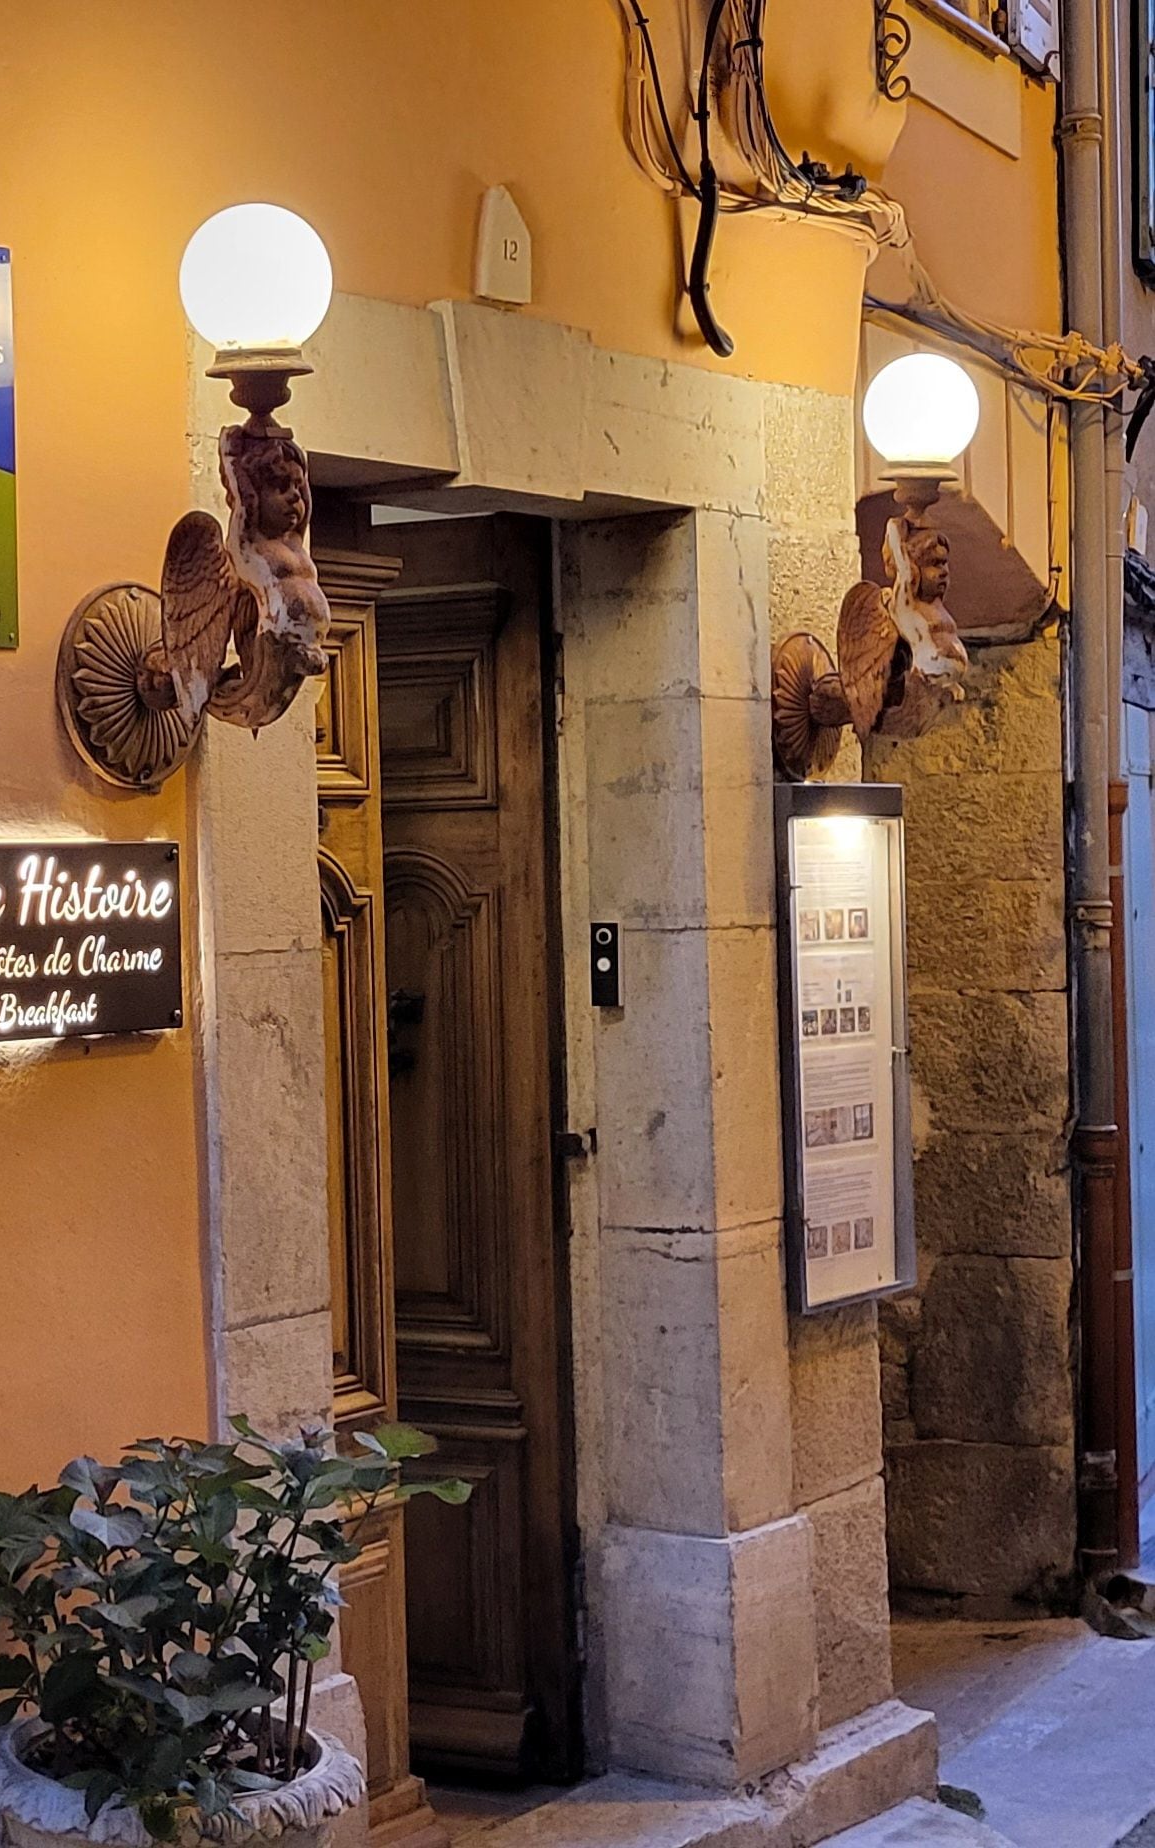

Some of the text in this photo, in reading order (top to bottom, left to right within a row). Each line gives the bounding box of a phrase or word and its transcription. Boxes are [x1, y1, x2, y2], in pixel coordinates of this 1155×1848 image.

[503, 238, 518, 262] 12
[19, 854, 173, 927] Histoire
[43, 936, 72, 977] de
[77, 934, 163, 977] Charme
